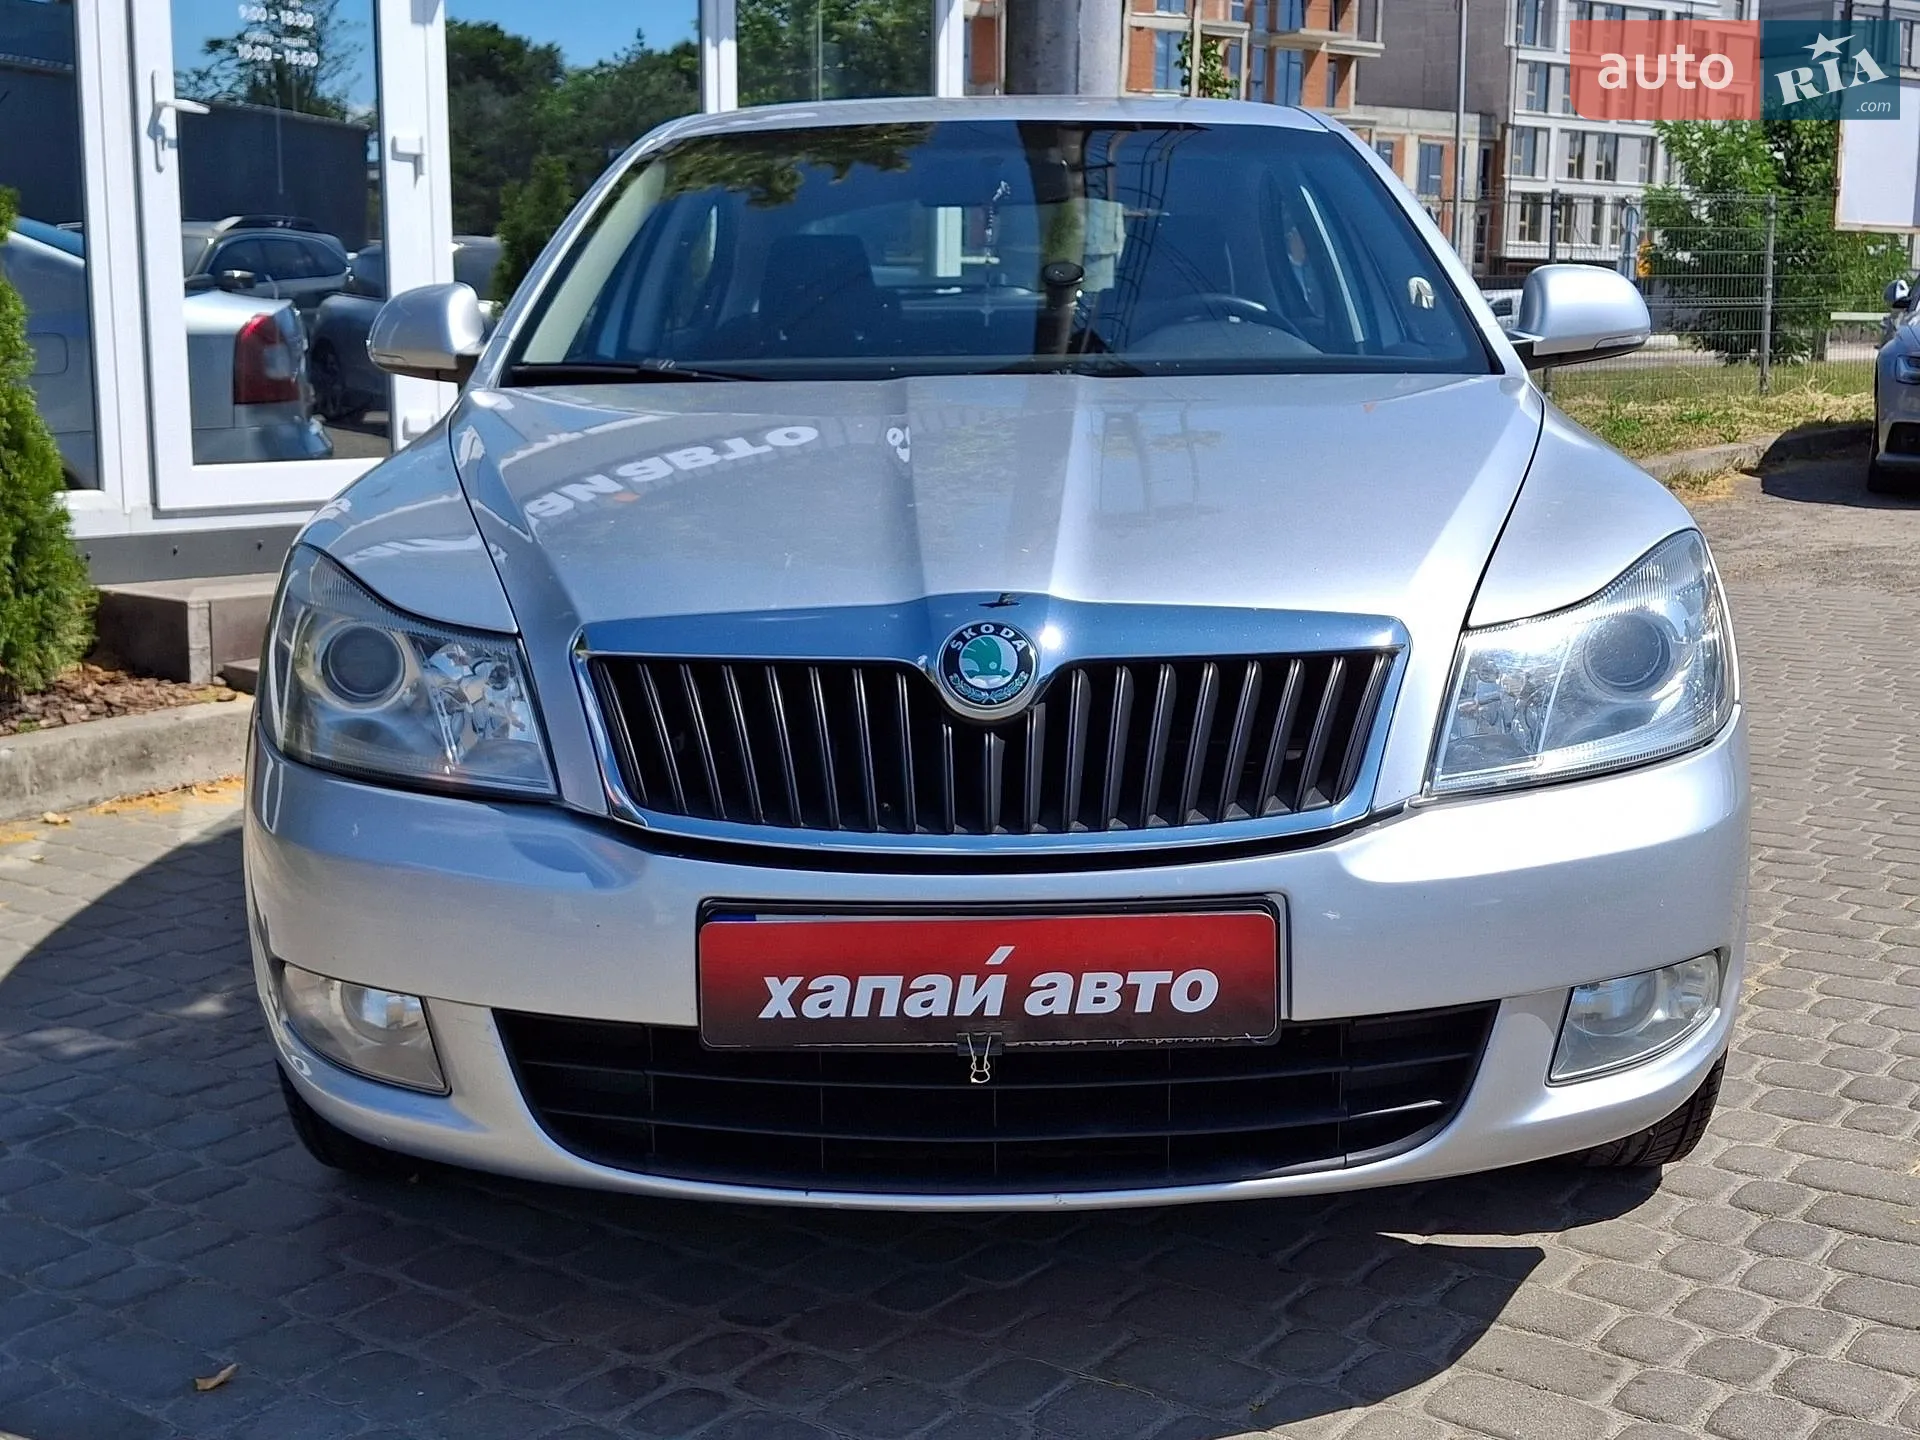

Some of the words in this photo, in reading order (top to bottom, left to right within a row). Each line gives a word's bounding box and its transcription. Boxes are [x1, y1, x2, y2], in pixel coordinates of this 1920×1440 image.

[238, 44, 272, 61] 10:00
[950, 623, 1027, 652] SKODA
[759, 945, 1015, 1020] хапай
[1024, 968, 1218, 1016] авто
